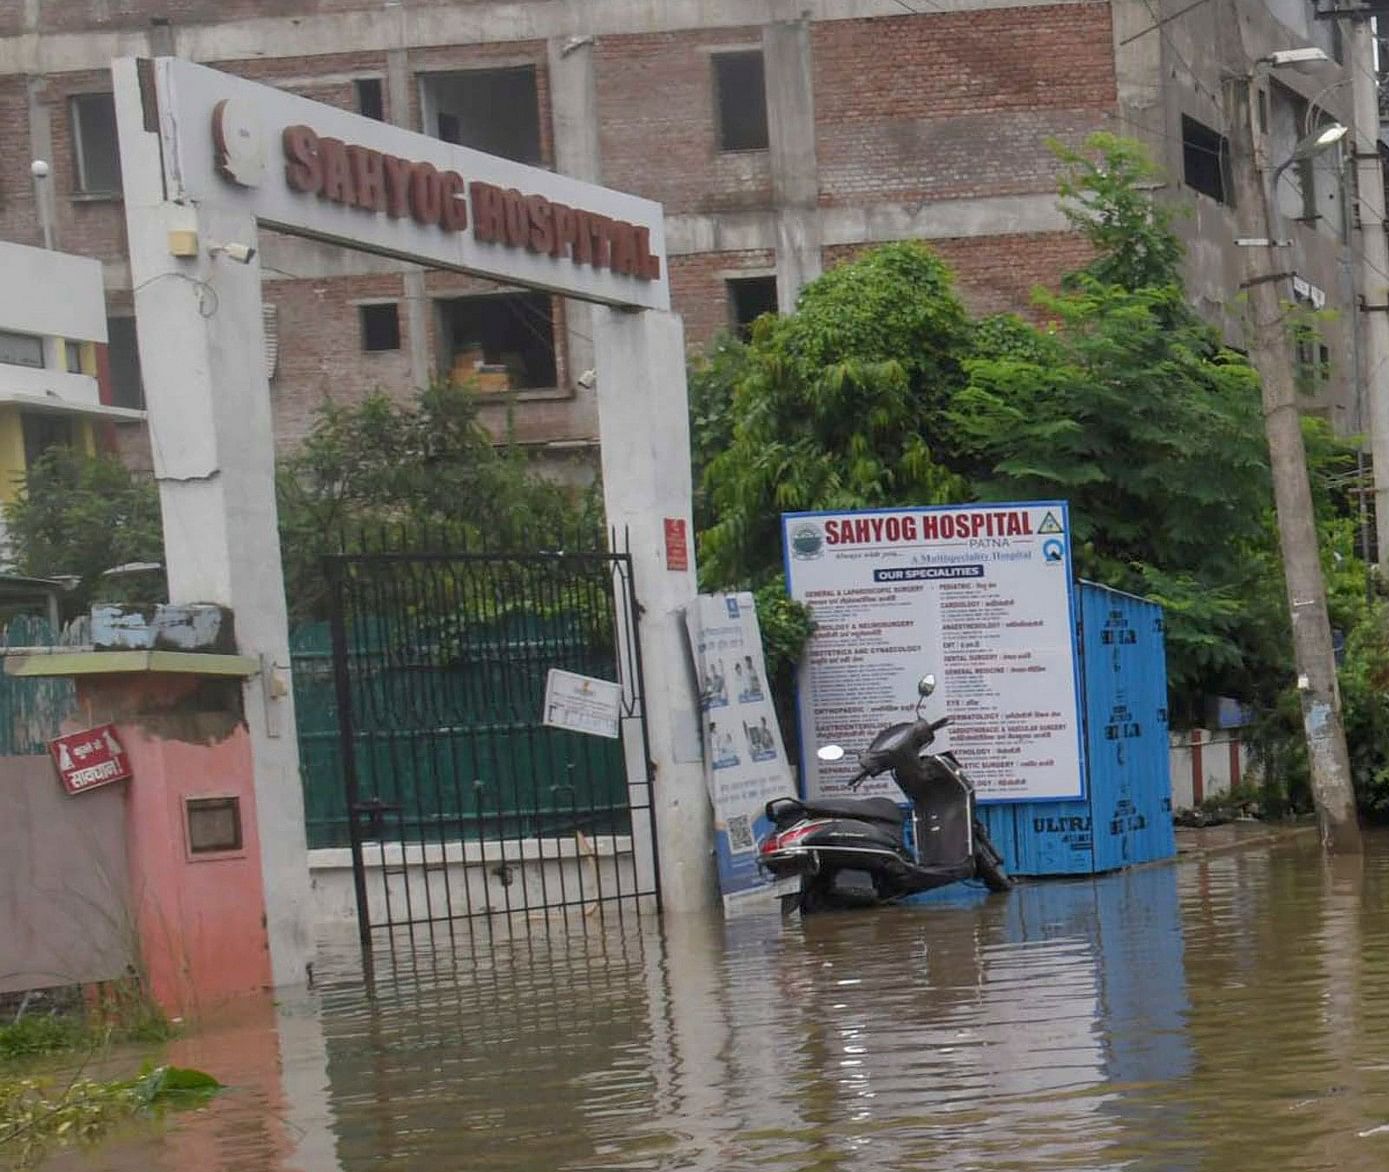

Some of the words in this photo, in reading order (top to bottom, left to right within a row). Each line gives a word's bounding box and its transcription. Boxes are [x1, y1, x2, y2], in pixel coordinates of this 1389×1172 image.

[283, 125, 467, 232] SAHYOG
[469, 181, 661, 281] HOSPITAL
[824, 515, 917, 545] SAHYOG
[922, 511, 1033, 540] HOSPITAL
[969, 538, 1011, 548] PATNA
[993, 550, 1032, 562] Hospital
[878, 571, 903, 580] OUR
[905, 567, 979, 579] SPECIALITIES
[894, 585, 924, 593] SURGERY
[940, 601, 980, 609] CARDIOLOGY
[815, 623, 850, 632] UROLOGY
[982, 760, 1014, 768] SURGERY
